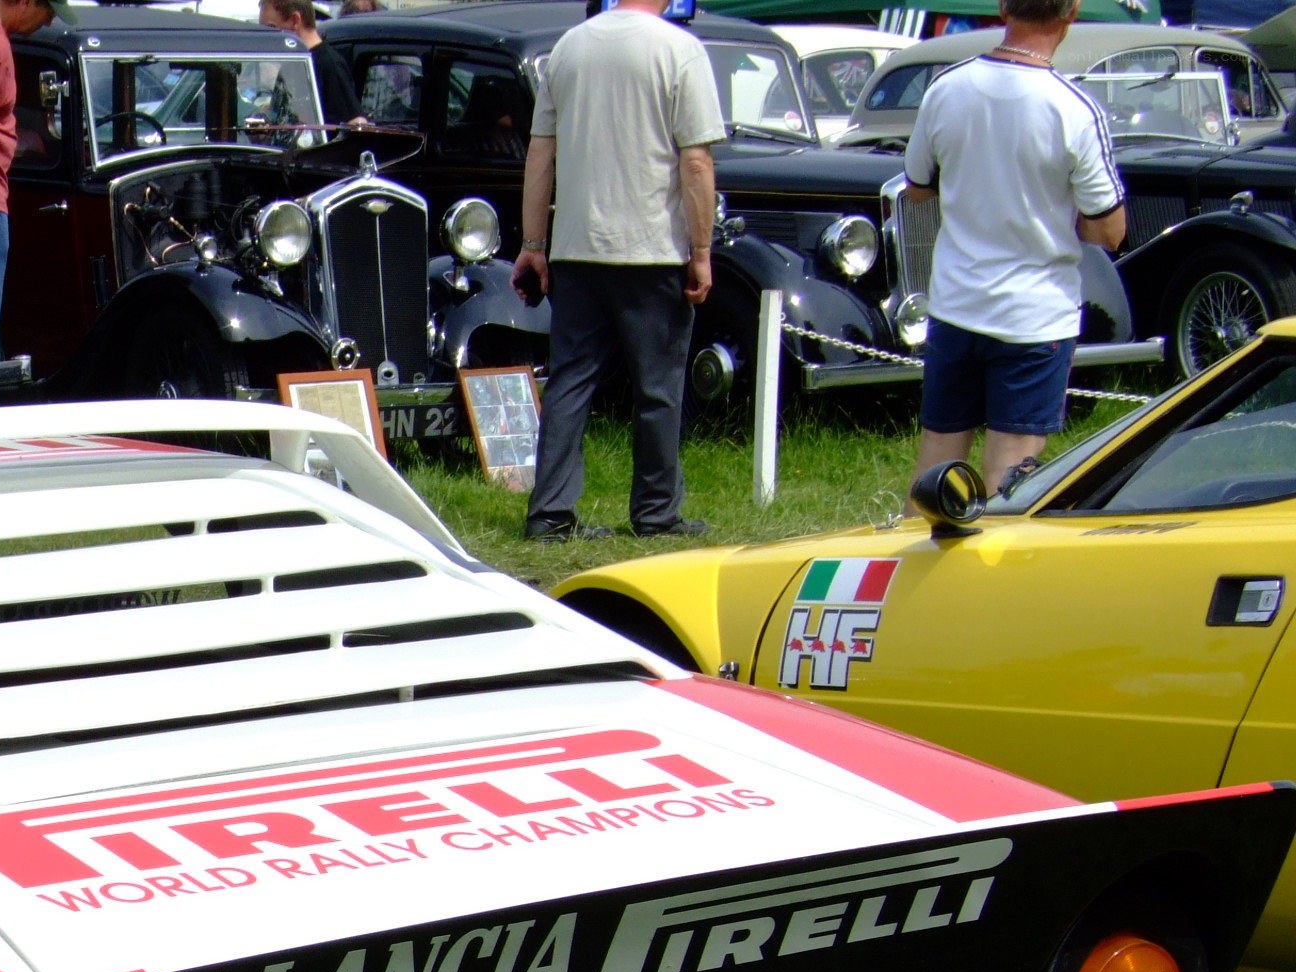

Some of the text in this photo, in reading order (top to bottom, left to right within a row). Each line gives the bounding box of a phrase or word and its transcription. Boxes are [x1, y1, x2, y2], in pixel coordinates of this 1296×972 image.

[778, 605, 882, 691] HF
[35, 788, 776, 912] WORLD RALLY CHAMPIONS
